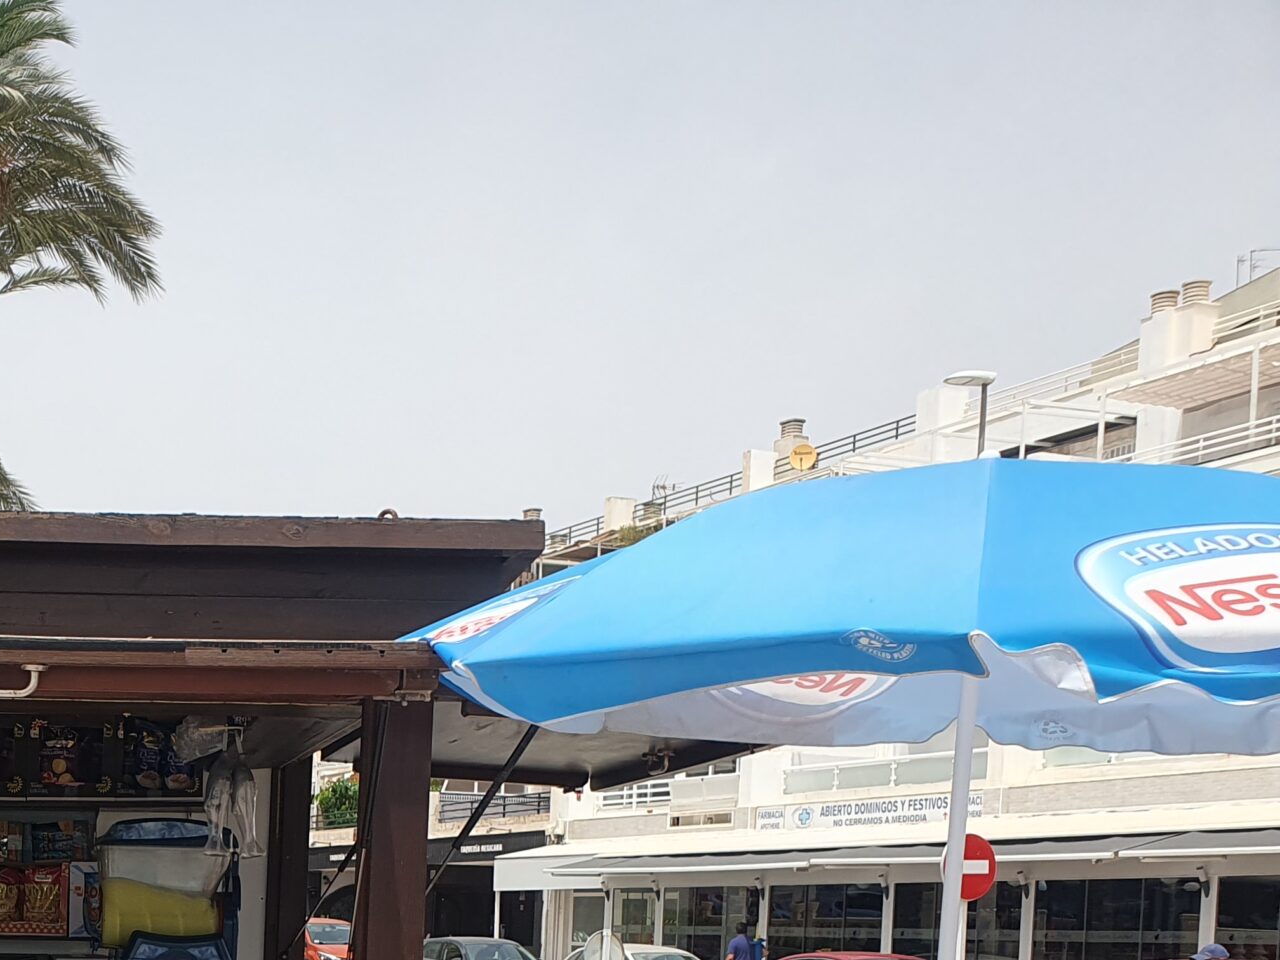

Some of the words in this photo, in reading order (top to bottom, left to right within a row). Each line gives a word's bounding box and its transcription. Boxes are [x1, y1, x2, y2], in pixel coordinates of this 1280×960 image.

[1118, 533, 1280, 566] HELADO
[1144, 574, 1280, 626] Nes
[758, 810, 783, 819] FARMACIA
[820, 803, 852, 817] ABIERTO
[854, 800, 898, 815] DOMINGOS
[900, 800, 906, 812] Y
[908, 796, 949, 811] FESTIVOS
[833, 819, 843, 827] NO
[845, 816, 883, 827] CERRAMOS
[885, 816, 890, 824] A
